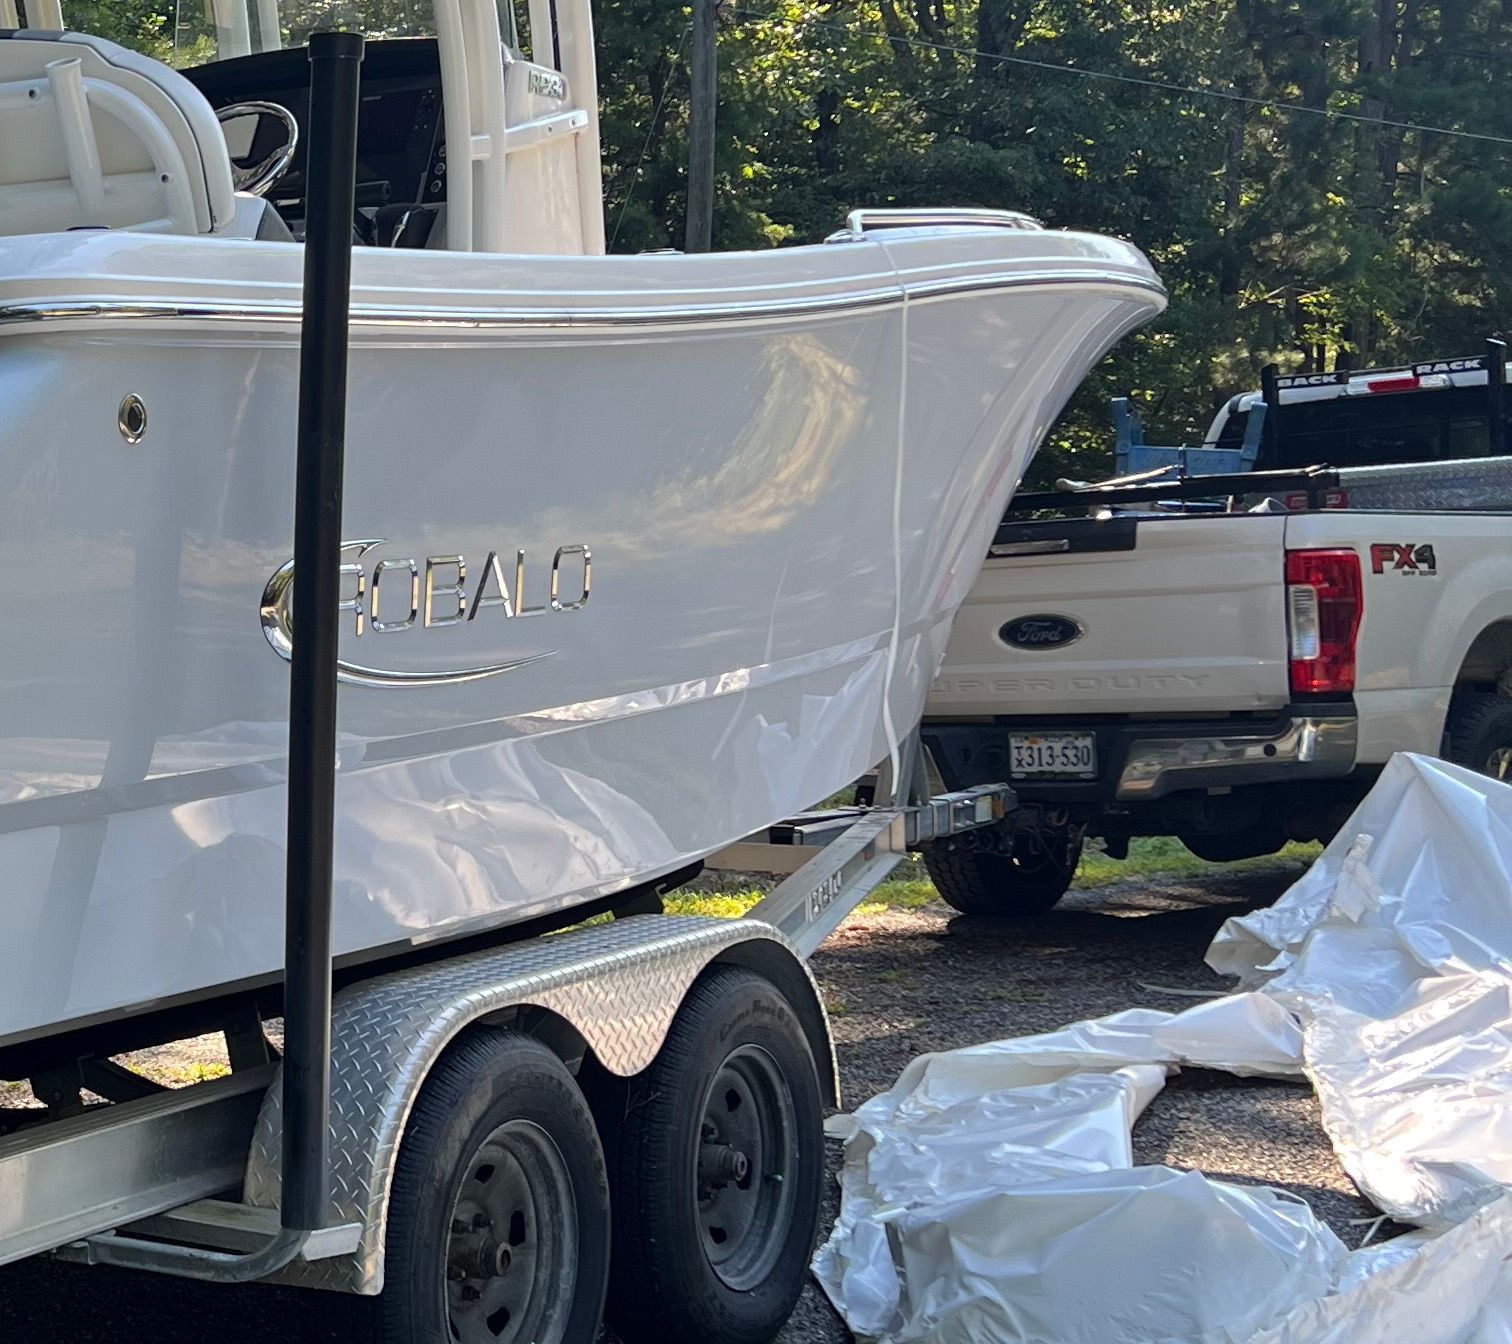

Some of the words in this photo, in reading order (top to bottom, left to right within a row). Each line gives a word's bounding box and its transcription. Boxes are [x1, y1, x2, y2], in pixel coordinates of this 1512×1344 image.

[1277, 374, 1338, 387] BACK
[1416, 359, 1482, 374] RACK
[1370, 543, 1437, 574] FX4
[1017, 621, 1062, 642] Ford
[931, 678, 1055, 693] UPER
[1069, 674, 1210, 691] DUTY
[1026, 745, 1091, 767] 313-530
